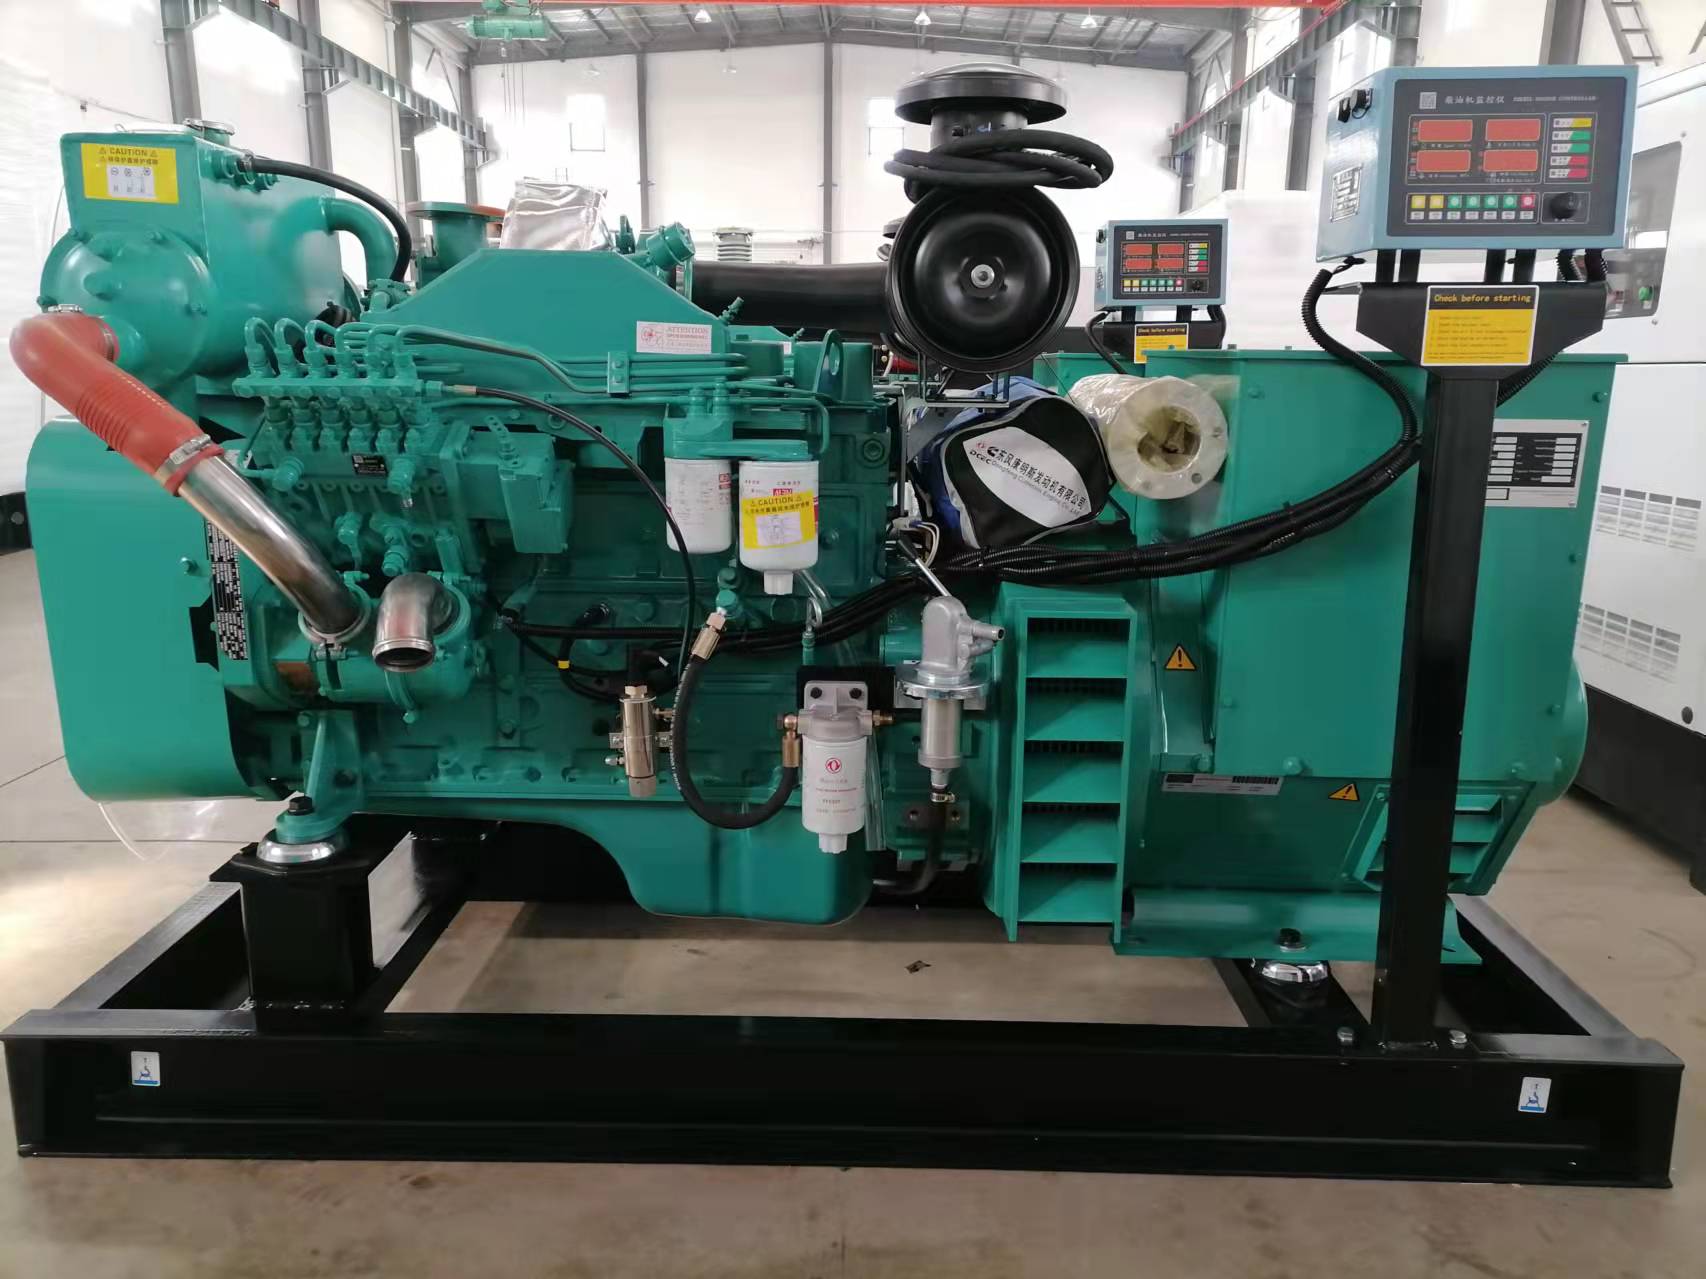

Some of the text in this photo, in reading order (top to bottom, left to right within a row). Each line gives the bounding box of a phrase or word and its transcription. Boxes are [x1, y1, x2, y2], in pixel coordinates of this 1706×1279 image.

[1445, 95, 1504, 105] 柴油机监控仪
[109, 147, 148, 157] CAUTION
[1434, 294, 1531, 304] Check before starting
[969, 449, 992, 465] DCEC
[995, 449, 1086, 510] 东风康明斯发动机有限公司
[758, 496, 794, 506] CAUTION
